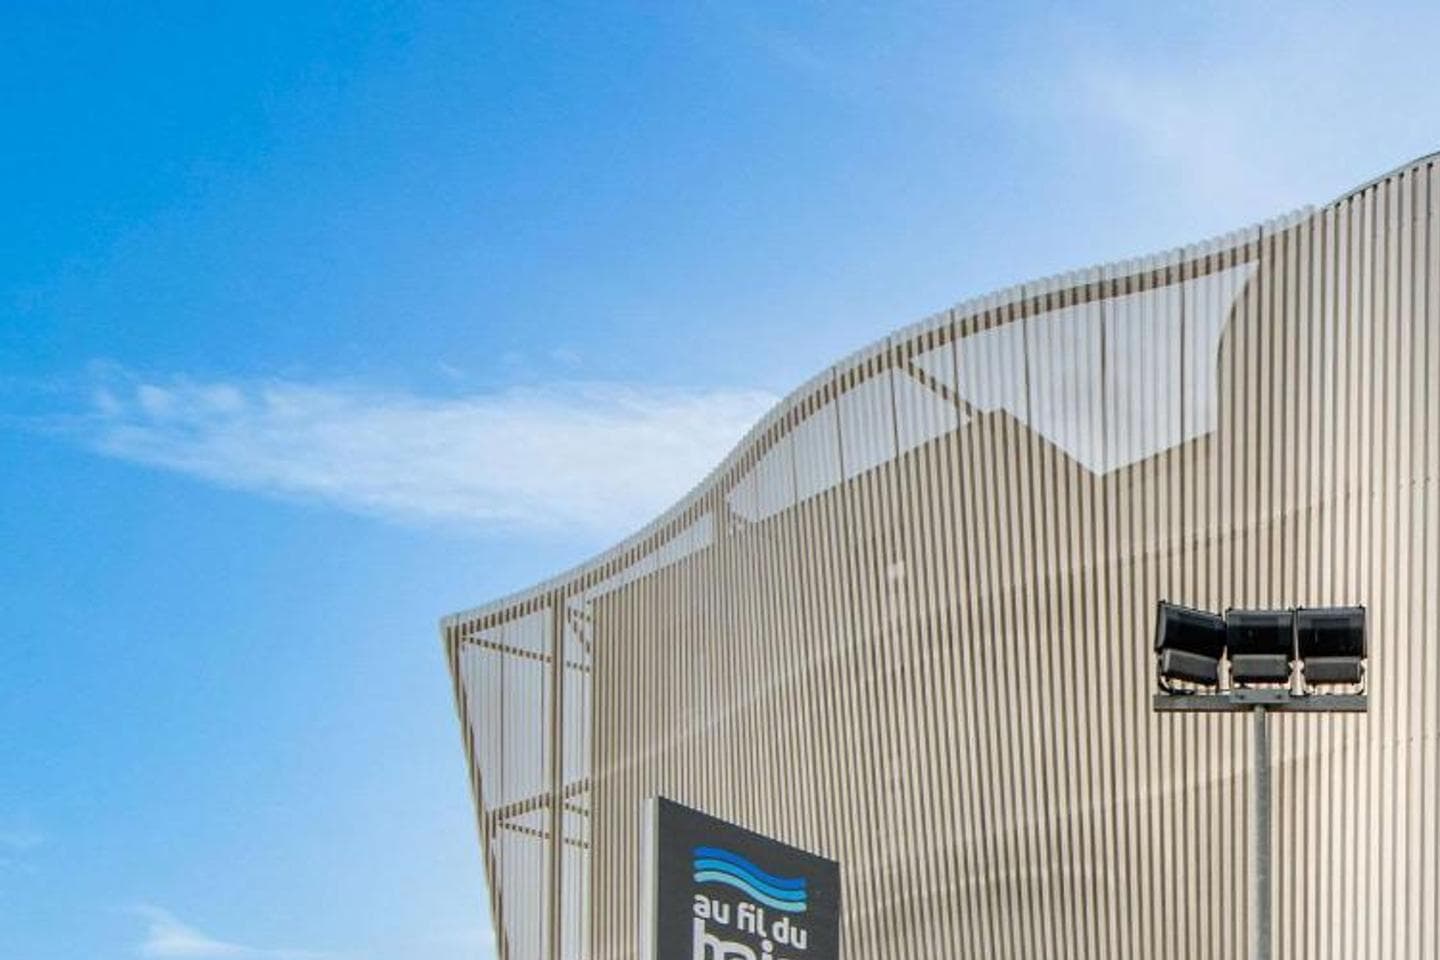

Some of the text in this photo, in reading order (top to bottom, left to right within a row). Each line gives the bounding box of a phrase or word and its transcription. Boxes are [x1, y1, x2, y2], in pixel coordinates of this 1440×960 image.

[693, 893, 807, 950] au fil du
